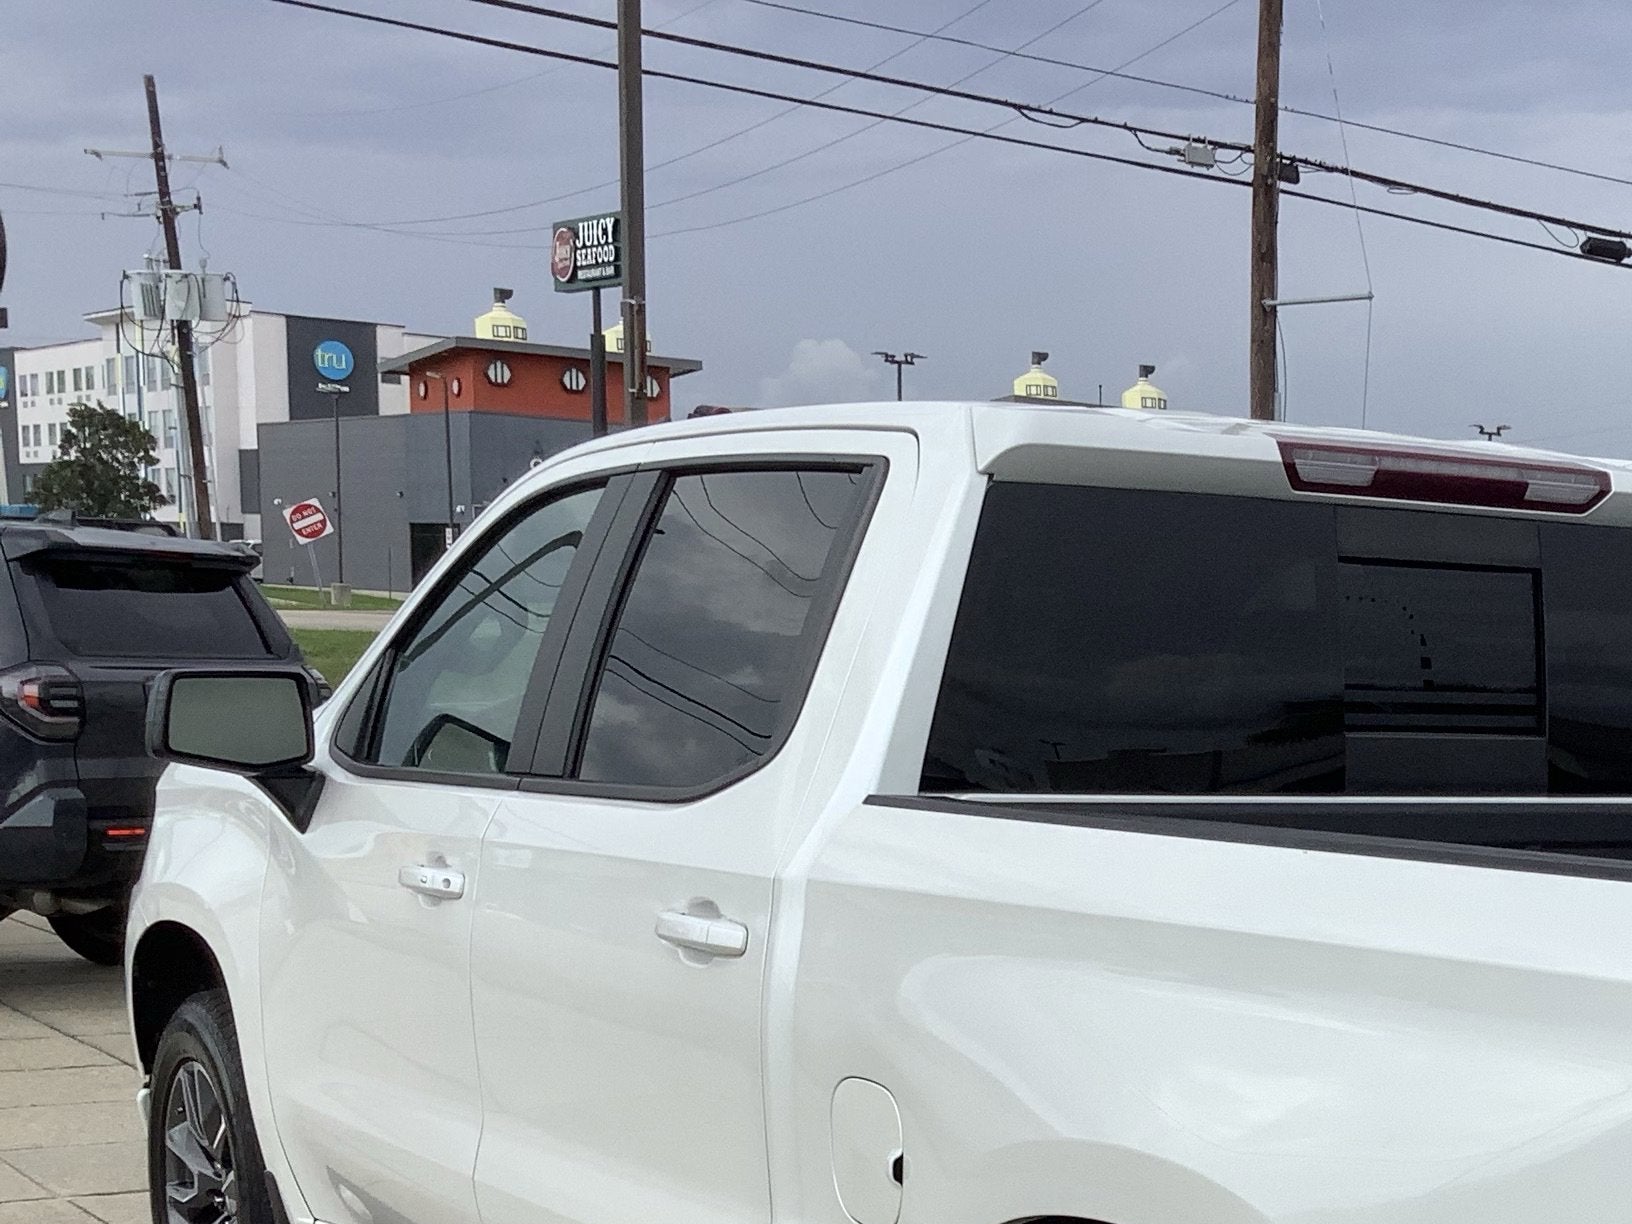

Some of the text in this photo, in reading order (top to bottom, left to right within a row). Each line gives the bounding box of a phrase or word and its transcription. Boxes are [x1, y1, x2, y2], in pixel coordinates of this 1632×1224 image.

[576, 217, 615, 248] JUICY
[576, 245, 615, 266] SEAFOOD
[316, 348, 346, 369] tru
[291, 506, 316, 521] DO NOT
[301, 522, 323, 535] ENTER
